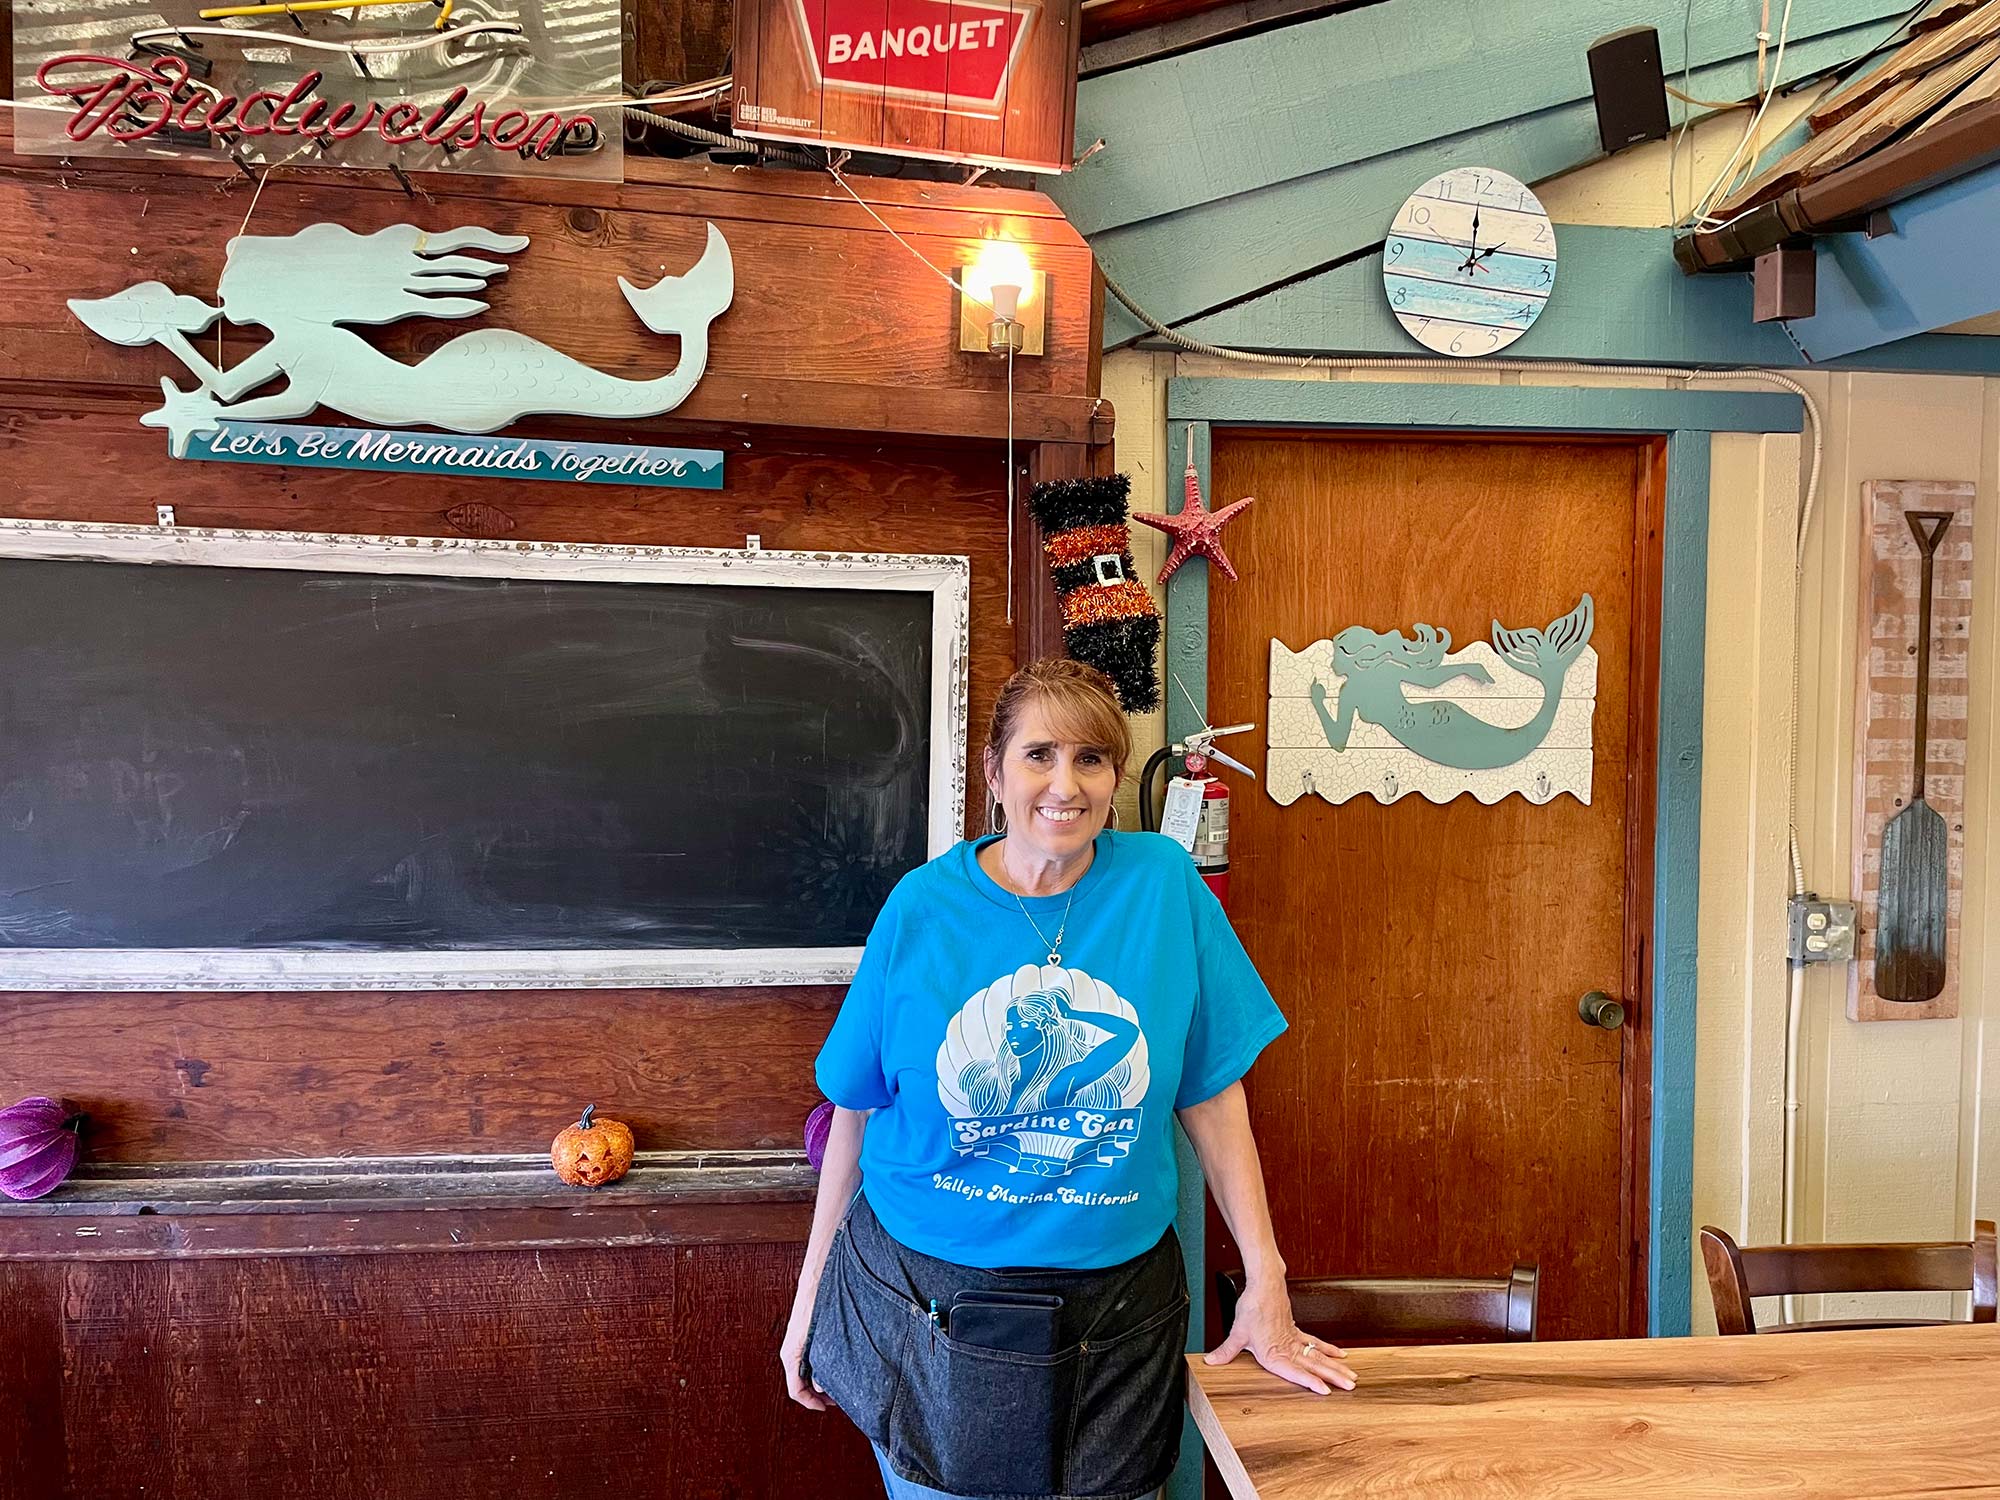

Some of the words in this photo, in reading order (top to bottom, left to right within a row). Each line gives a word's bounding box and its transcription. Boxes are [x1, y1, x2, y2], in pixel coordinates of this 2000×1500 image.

[827, 18, 1004, 64] BANQUET
[1438, 179, 1454, 199] 11
[1473, 174, 1494, 196] 12
[1518, 191, 1525, 211] 1
[1408, 204, 1431, 225] 10
[1532, 223, 1546, 243] 2
[1387, 242, 1404, 266] 9
[1536, 264, 1551, 287] 3
[1393, 287, 1406, 305] 8
[1517, 304, 1534, 323] 4
[1416, 318, 1431, 338] 7
[1450, 331, 1465, 353] 6
[1488, 329, 1501, 349] 5
[210, 426, 288, 456] Let's
[296, 431, 342, 459] Be
[346, 431, 542, 470] Mermaids
[550, 445, 688, 481] Together
[954, 1114, 1071, 1143] Sardine
[1075, 1110, 1135, 1137] Can
[932, 1173, 984, 1201] Vallejo
[1057, 1186, 1140, 1206] California
